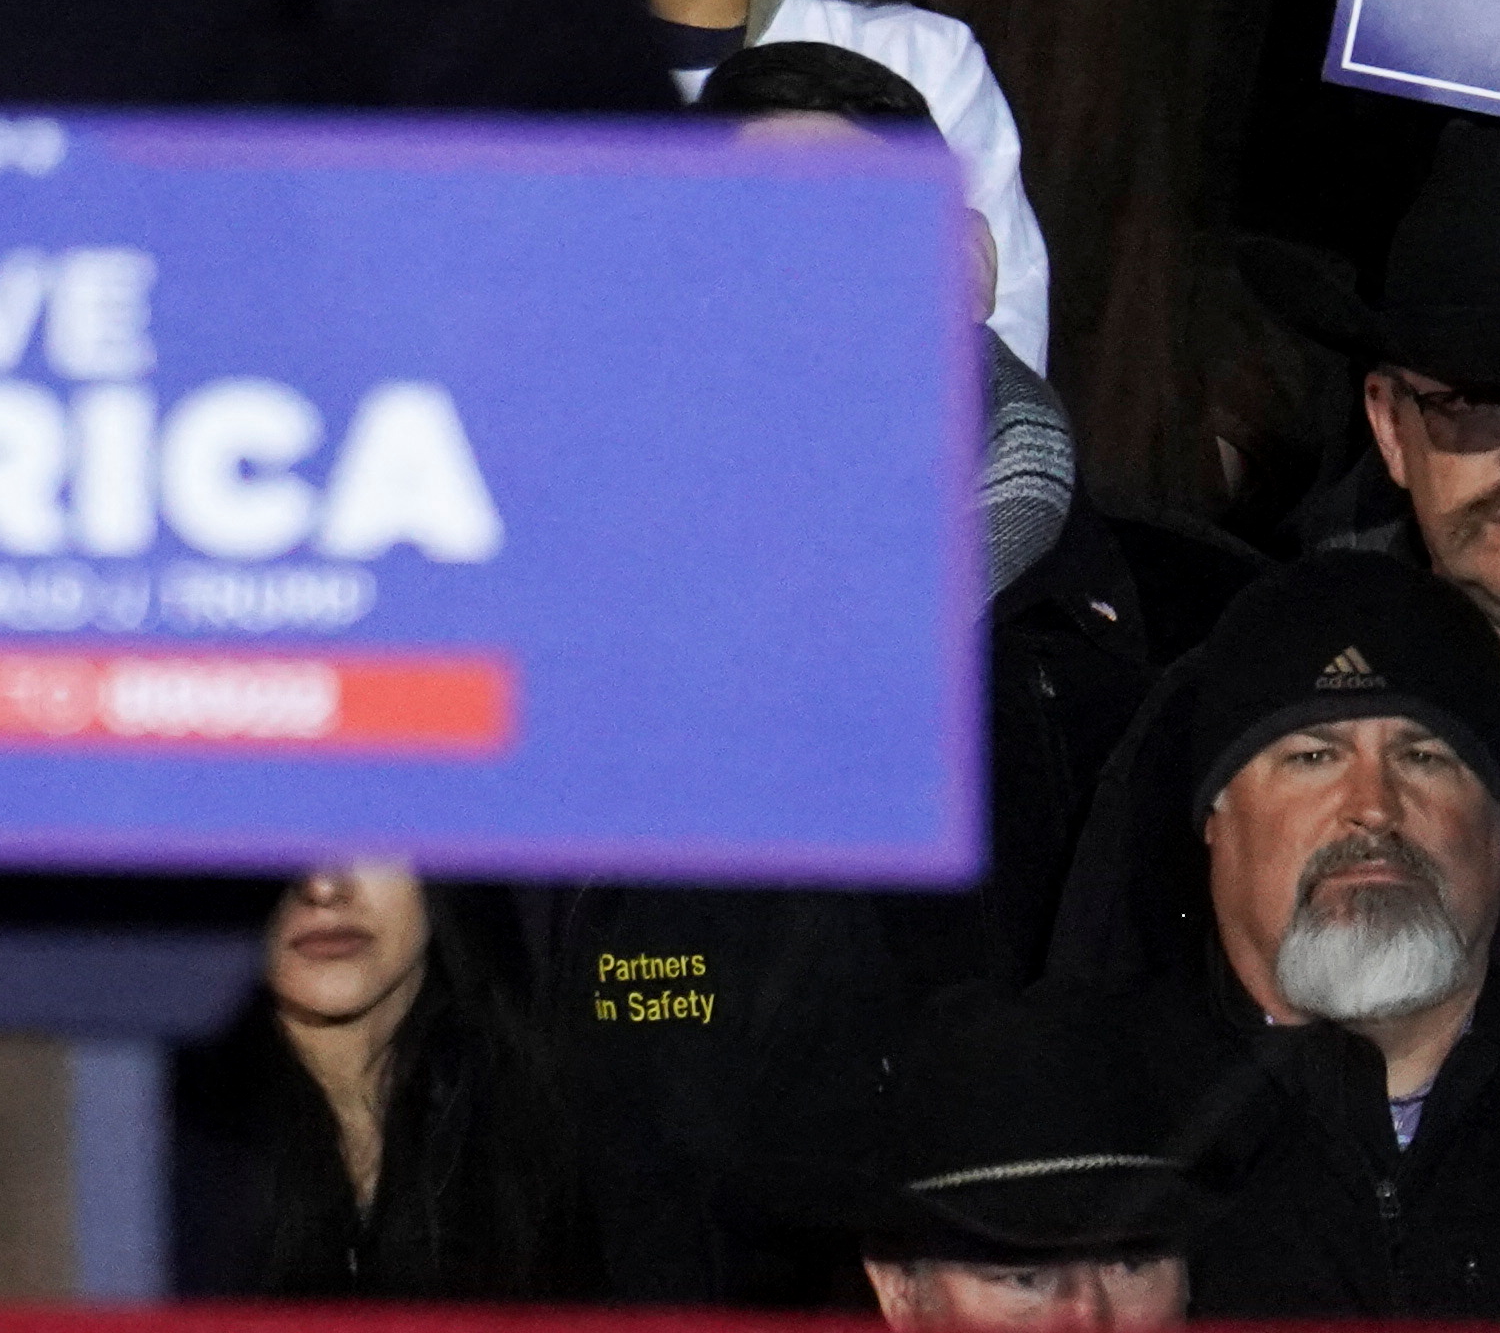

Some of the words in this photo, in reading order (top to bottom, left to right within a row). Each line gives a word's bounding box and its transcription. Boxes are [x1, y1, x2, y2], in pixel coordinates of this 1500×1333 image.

[598, 953, 706, 982] Partners
[594, 991, 617, 1021] in
[627, 989, 716, 1024] Safety
